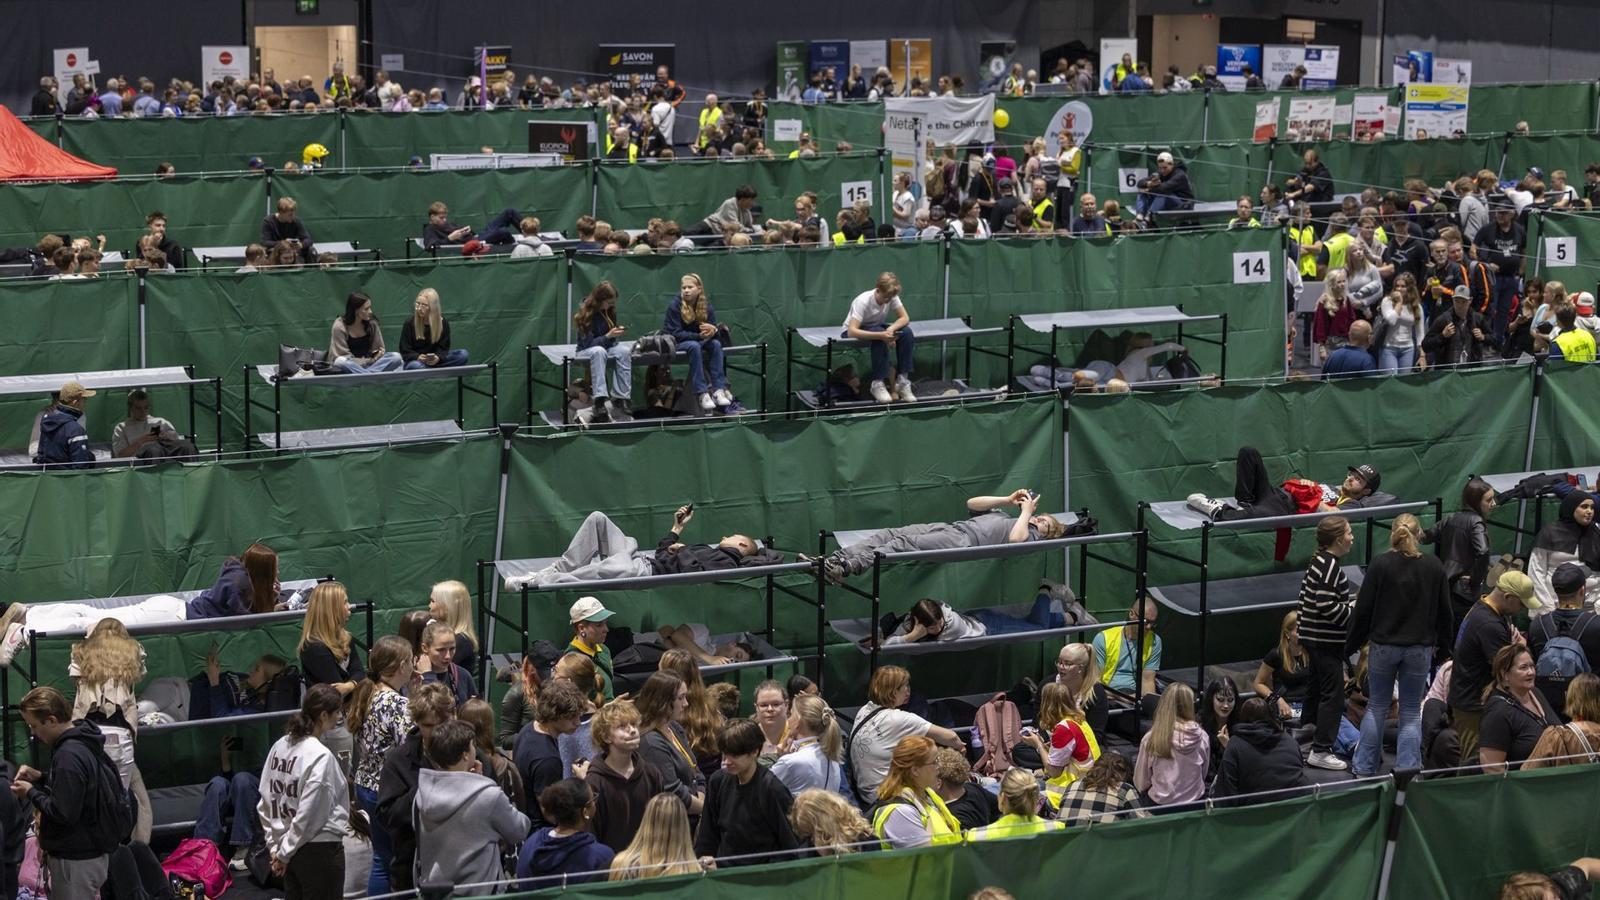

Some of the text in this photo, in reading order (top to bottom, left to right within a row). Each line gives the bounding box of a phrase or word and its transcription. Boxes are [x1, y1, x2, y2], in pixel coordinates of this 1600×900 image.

[935, 121, 950, 129] the
[1126, 174, 1137, 187] 6
[847, 187, 867, 201] 15
[1557, 244, 1566, 260] 5
[1241, 258, 1265, 276] 14
[271, 752, 298, 775] bad
